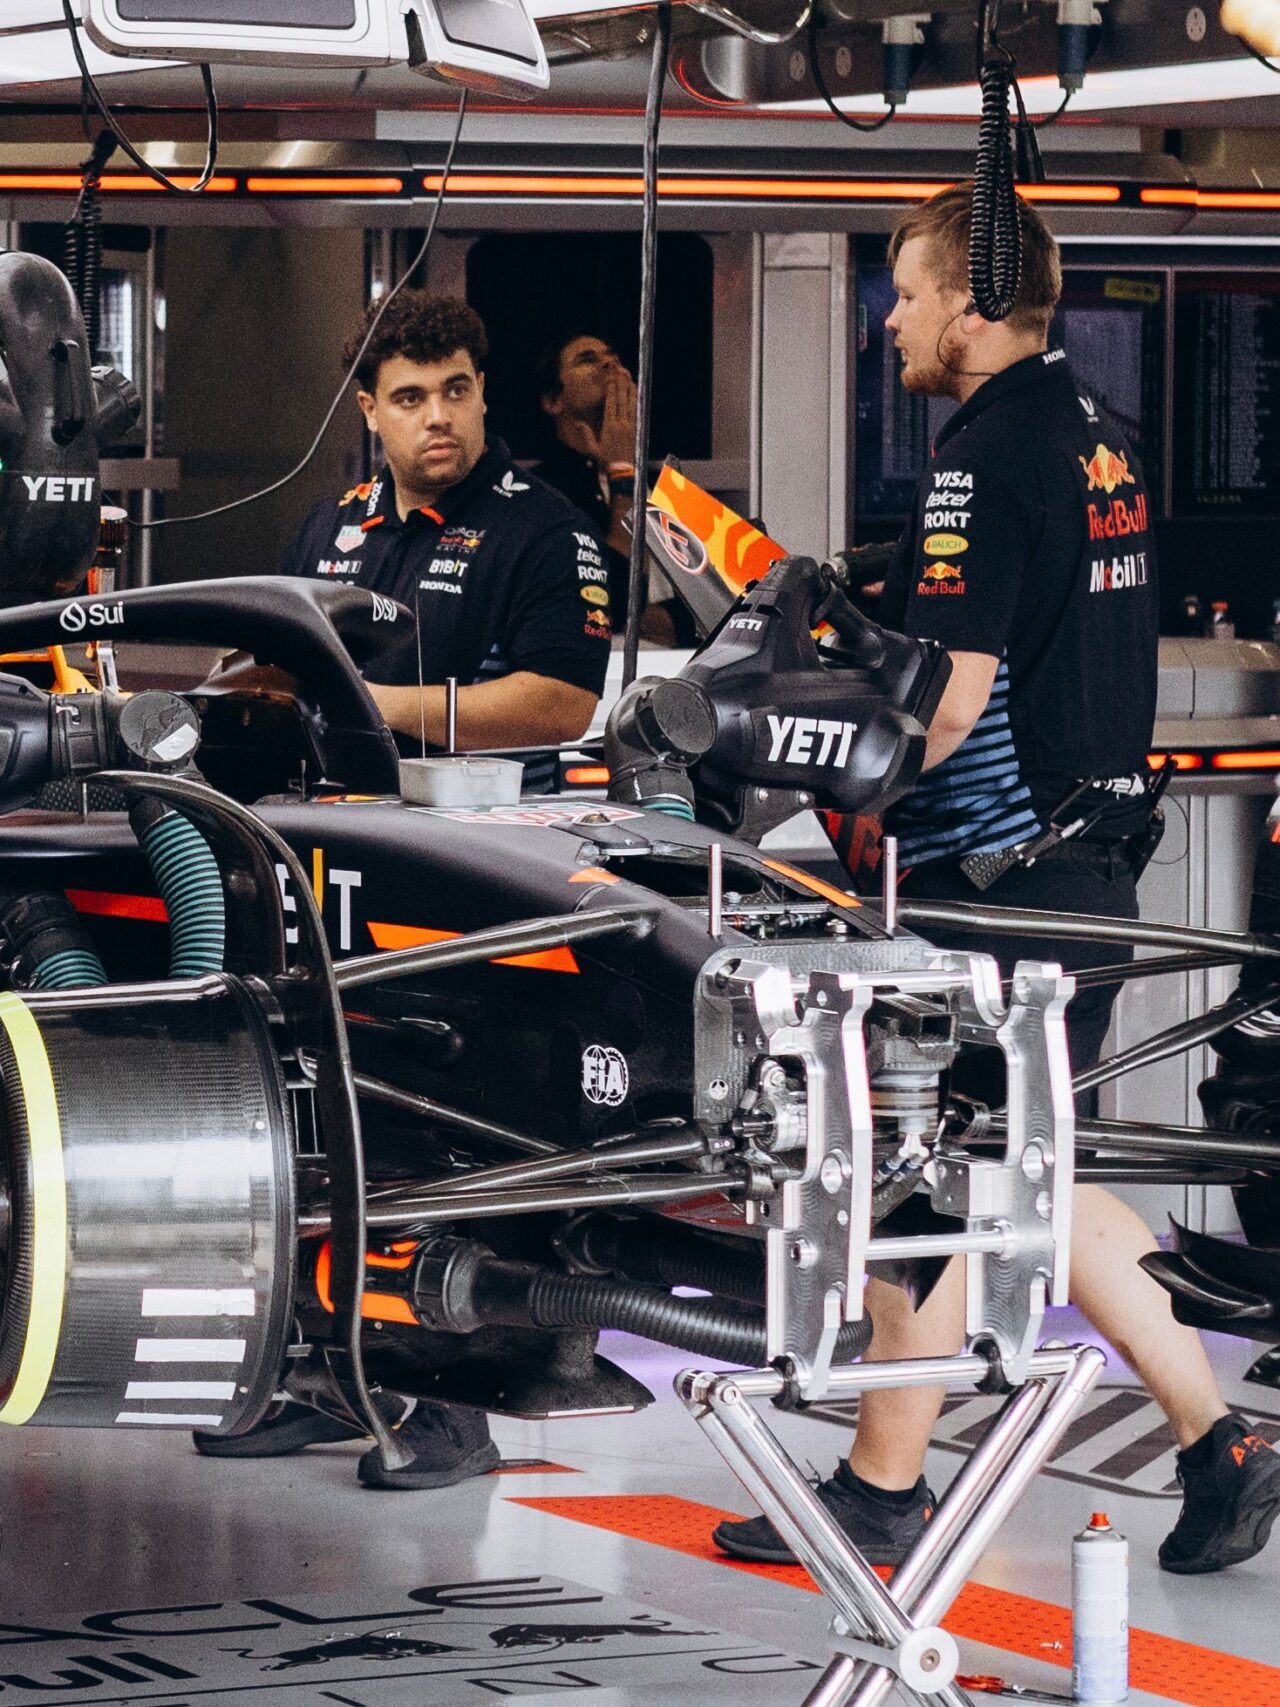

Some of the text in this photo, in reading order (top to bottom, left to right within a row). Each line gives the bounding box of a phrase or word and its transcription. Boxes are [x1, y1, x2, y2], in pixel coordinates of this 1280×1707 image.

[22, 475, 94, 502] YETI
[933, 471, 974, 489] VISA
[366, 482, 384, 517] zoom
[925, 490, 973, 508] telcel
[924, 510, 972, 530] ROKT
[1087, 494, 1148, 541] Red Bull
[1089, 554, 1137, 593] Mobil
[419, 579, 464, 595] HONDA
[917, 581, 966, 596] Red Bull
[89, 601, 125, 627] Sui
[729, 618, 763, 631] YETI
[767, 715, 856, 768] YETI
